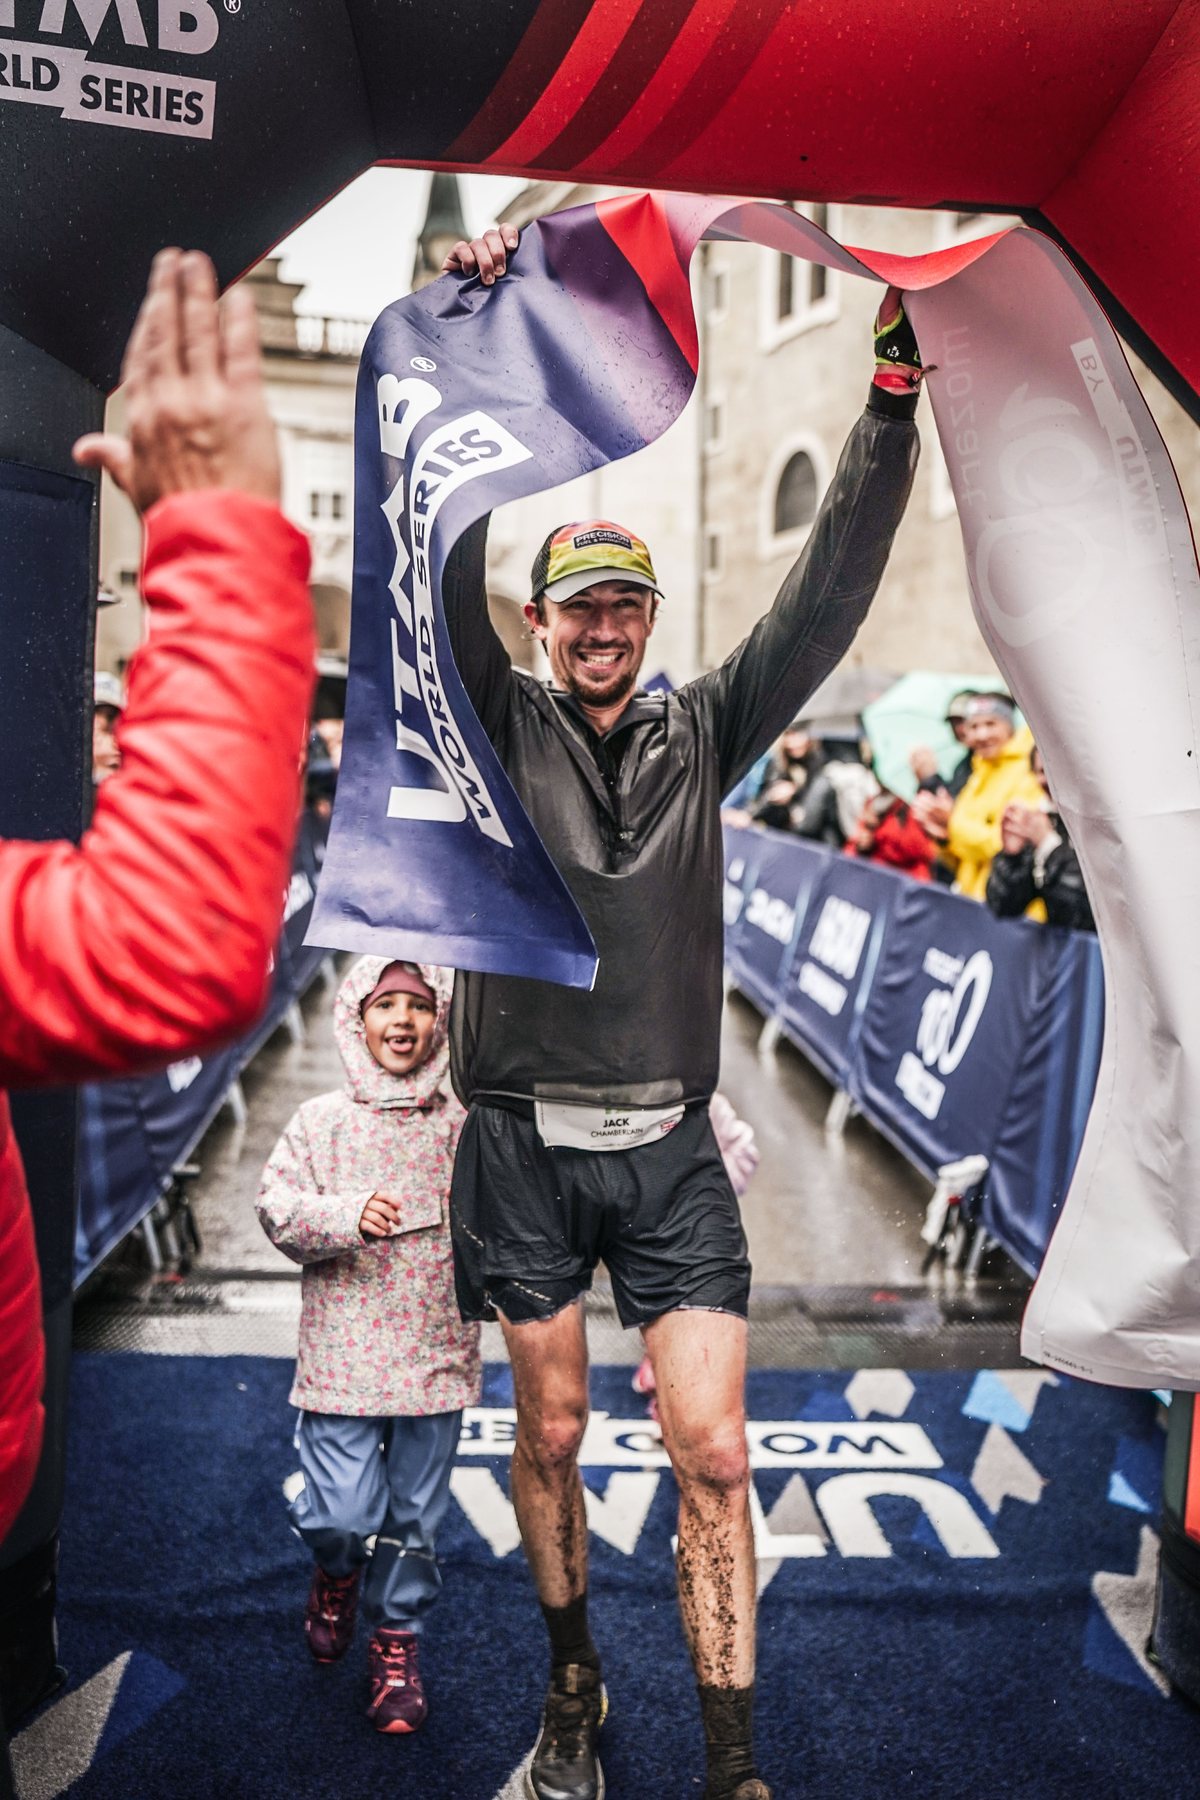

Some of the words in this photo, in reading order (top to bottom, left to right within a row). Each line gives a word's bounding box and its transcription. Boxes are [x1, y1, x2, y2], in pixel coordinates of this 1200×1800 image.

[79, 74, 204, 126] SERIES
[411, 428, 503, 592] SERIES
[576, 531, 629, 543] PRECISION
[417, 612, 492, 820] WORLD
[591, 1127, 644, 1138] CHAMBERLAIN
[603, 1117, 629, 1128] JACK
